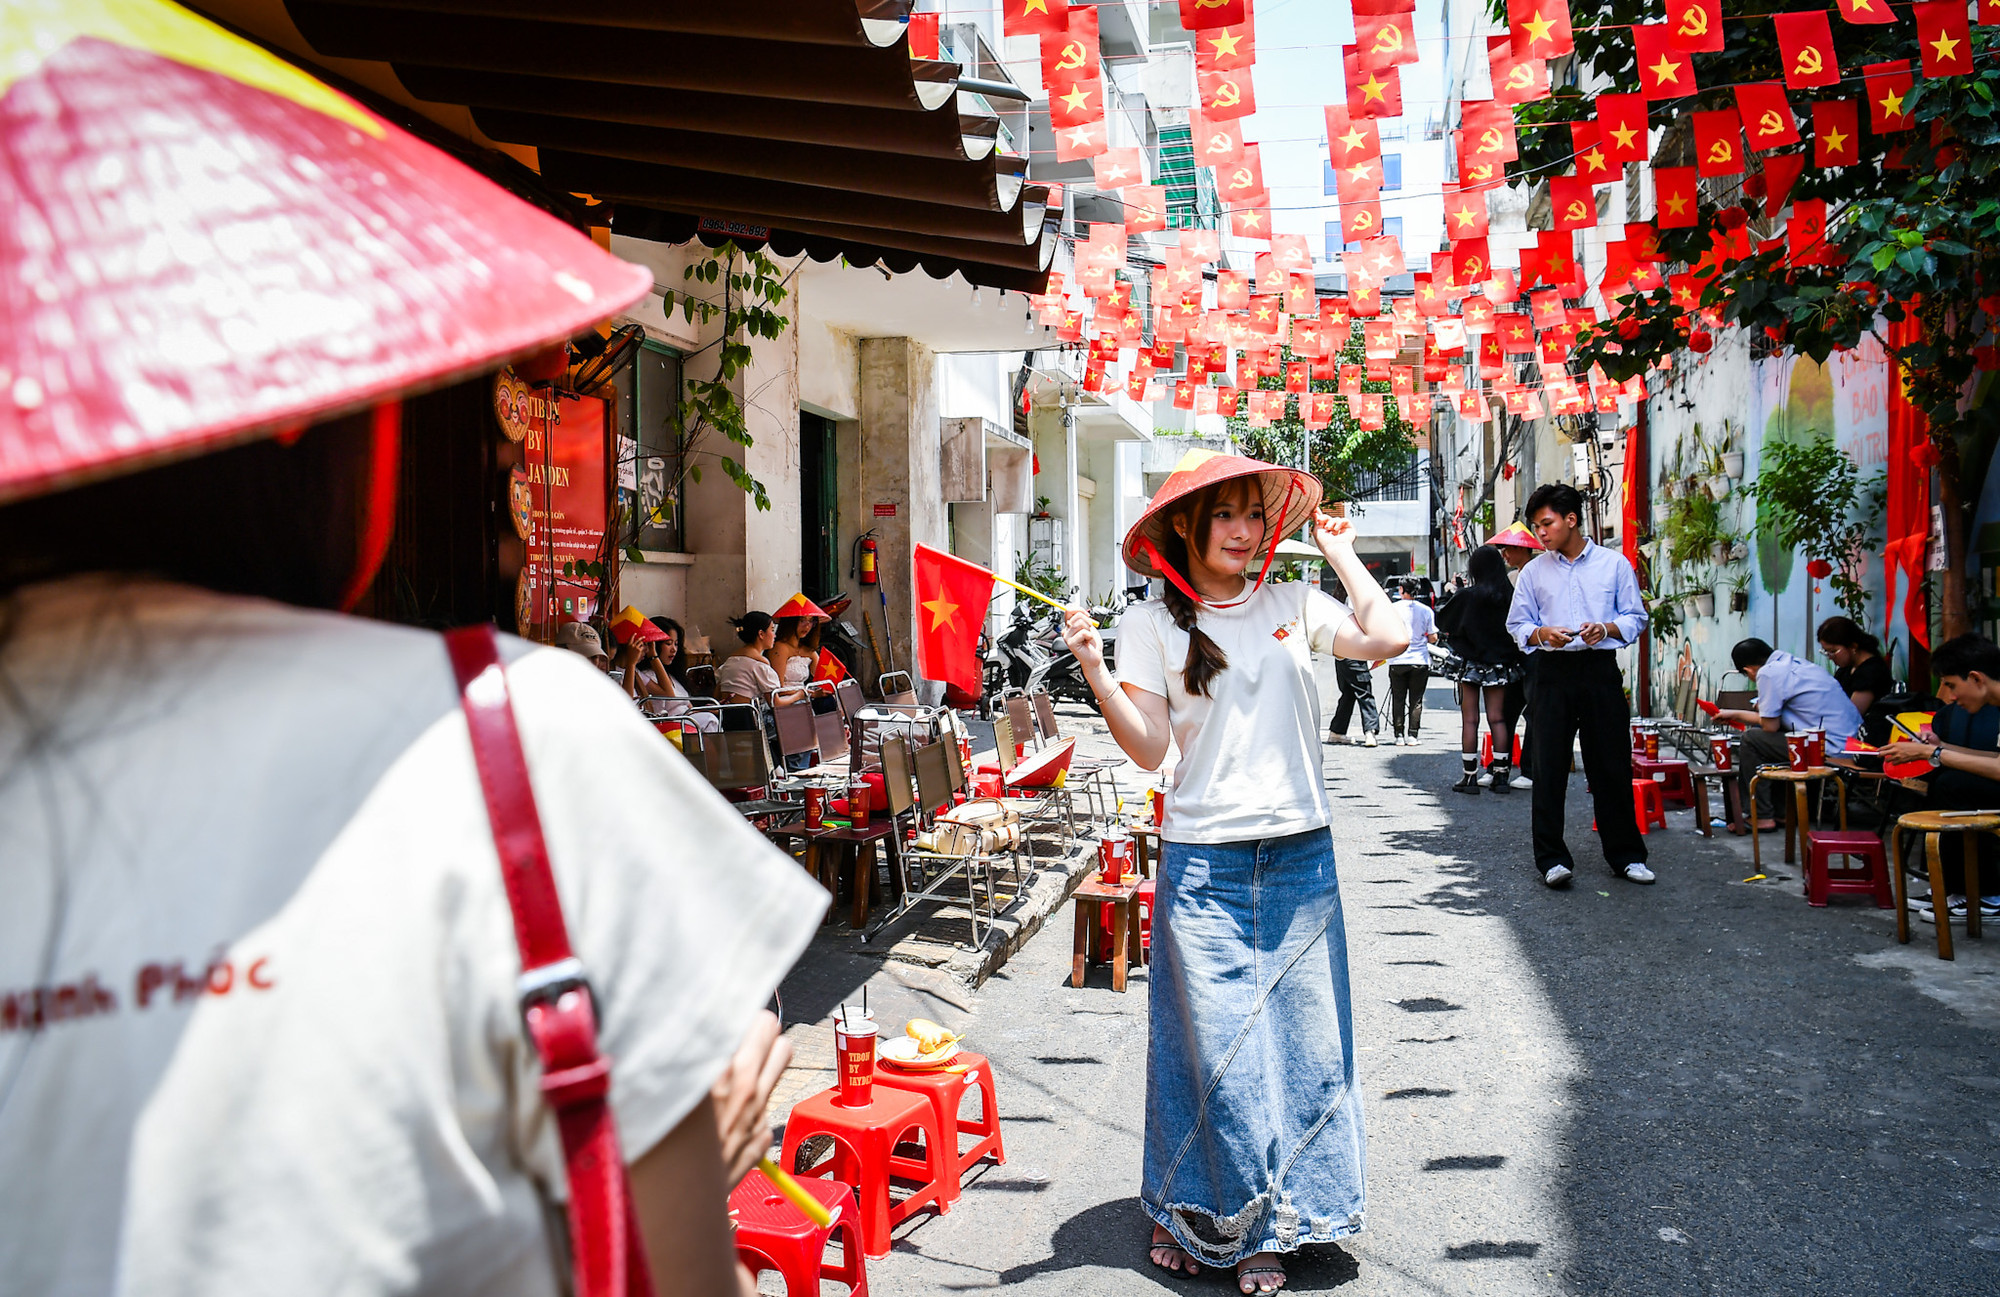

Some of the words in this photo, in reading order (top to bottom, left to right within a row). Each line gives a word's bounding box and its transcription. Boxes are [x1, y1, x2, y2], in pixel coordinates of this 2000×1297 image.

[702, 218, 767, 237] 0964.992.892
[527, 429, 542, 451] BY
[848, 1051, 871, 1062] TIBON
[848, 1064, 860, 1074] BY
